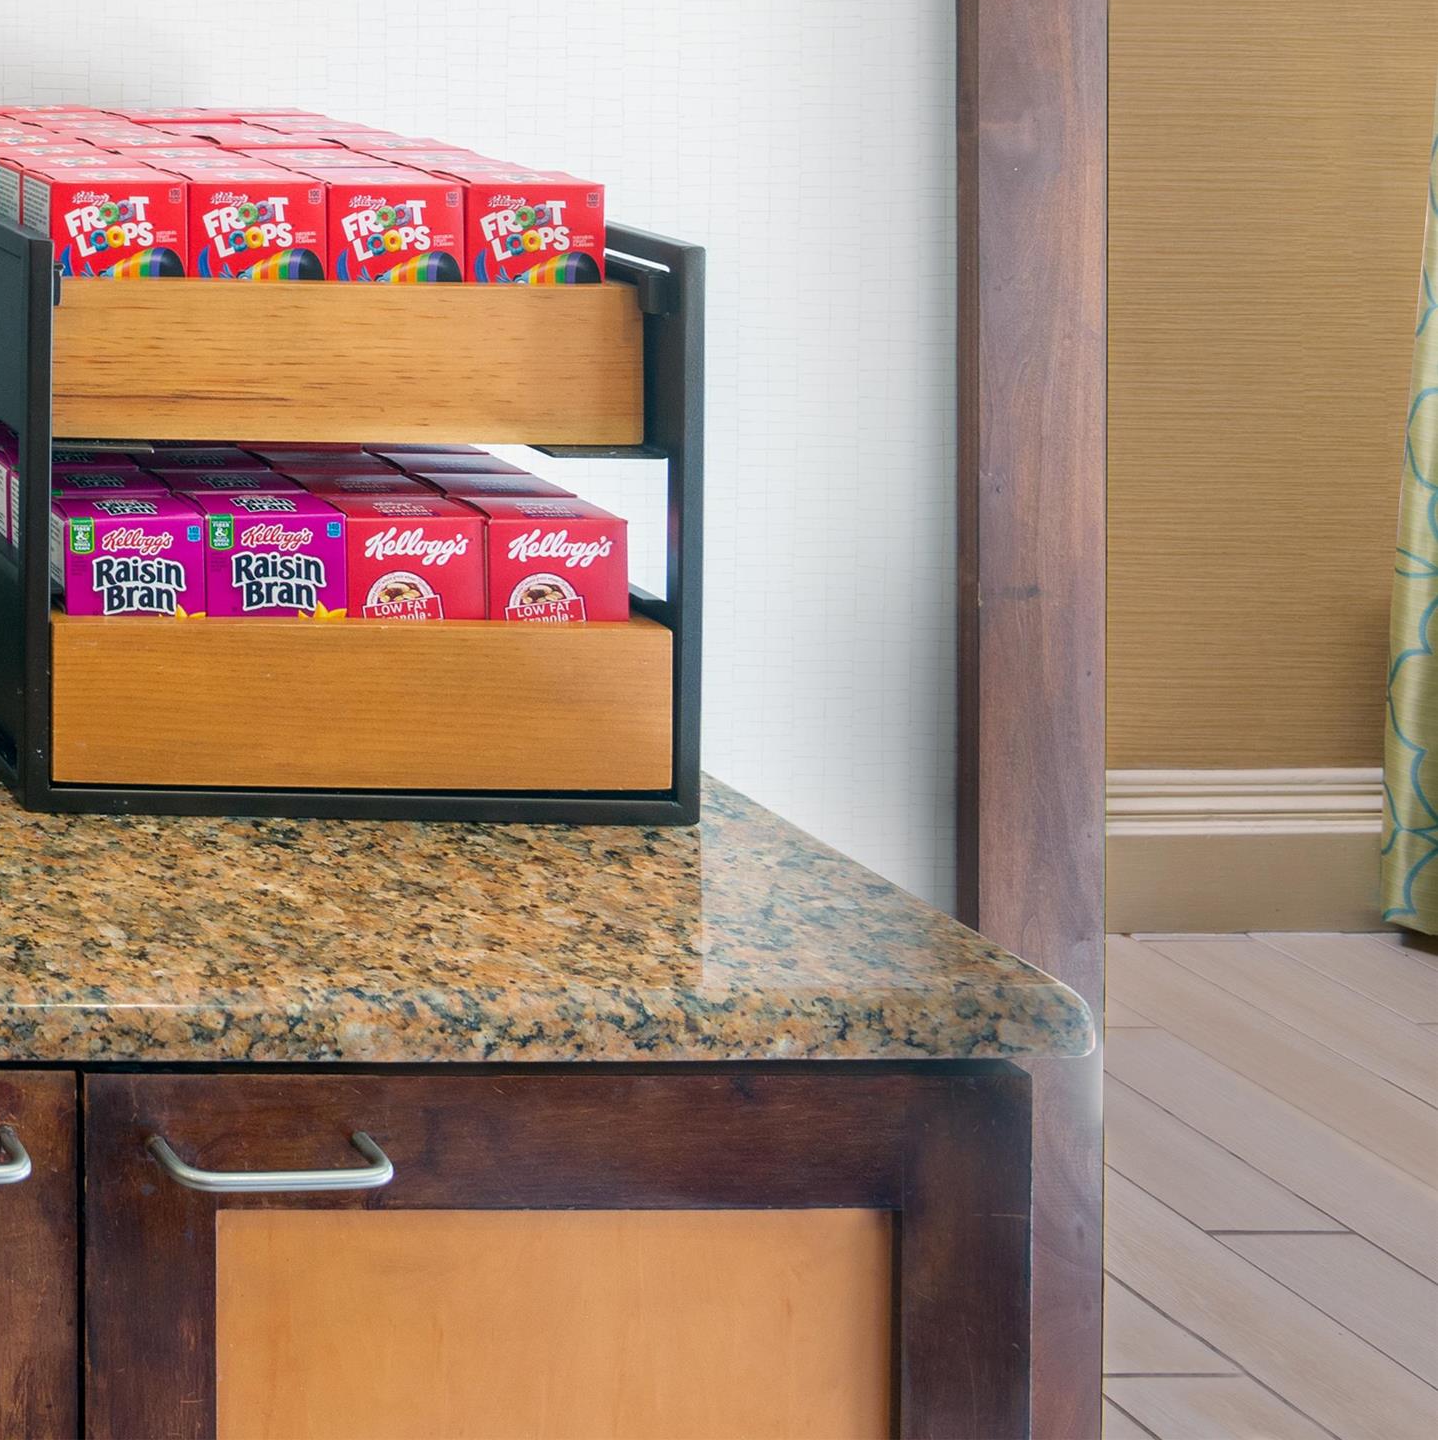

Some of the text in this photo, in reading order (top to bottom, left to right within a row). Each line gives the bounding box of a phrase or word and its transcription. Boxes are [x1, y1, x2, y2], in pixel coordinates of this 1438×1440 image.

[64, 196, 149, 238] FROOT
[202, 197, 288, 238] FROOT
[341, 200, 426, 242] FROOT
[480, 200, 566, 241] FROOT
[76, 222, 154, 257] LOOPS
[214, 222, 292, 258] LOOPS
[353, 226, 430, 261] LOOPS
[491, 226, 569, 261] LOOPS
[102, 527, 173, 555] Kellogg's
[241, 524, 313, 550] Kellogg's
[364, 526, 469, 566] Kellogg's
[507, 529, 613, 568] Kellogg's
[93, 556, 186, 591] Raisin
[231, 551, 326, 587] Raisin
[104, 583, 177, 615] Bran
[243, 580, 316, 611] Bran
[374, 600, 427, 616] LOW FAT
[517, 601, 570, 618] LOW FAT
